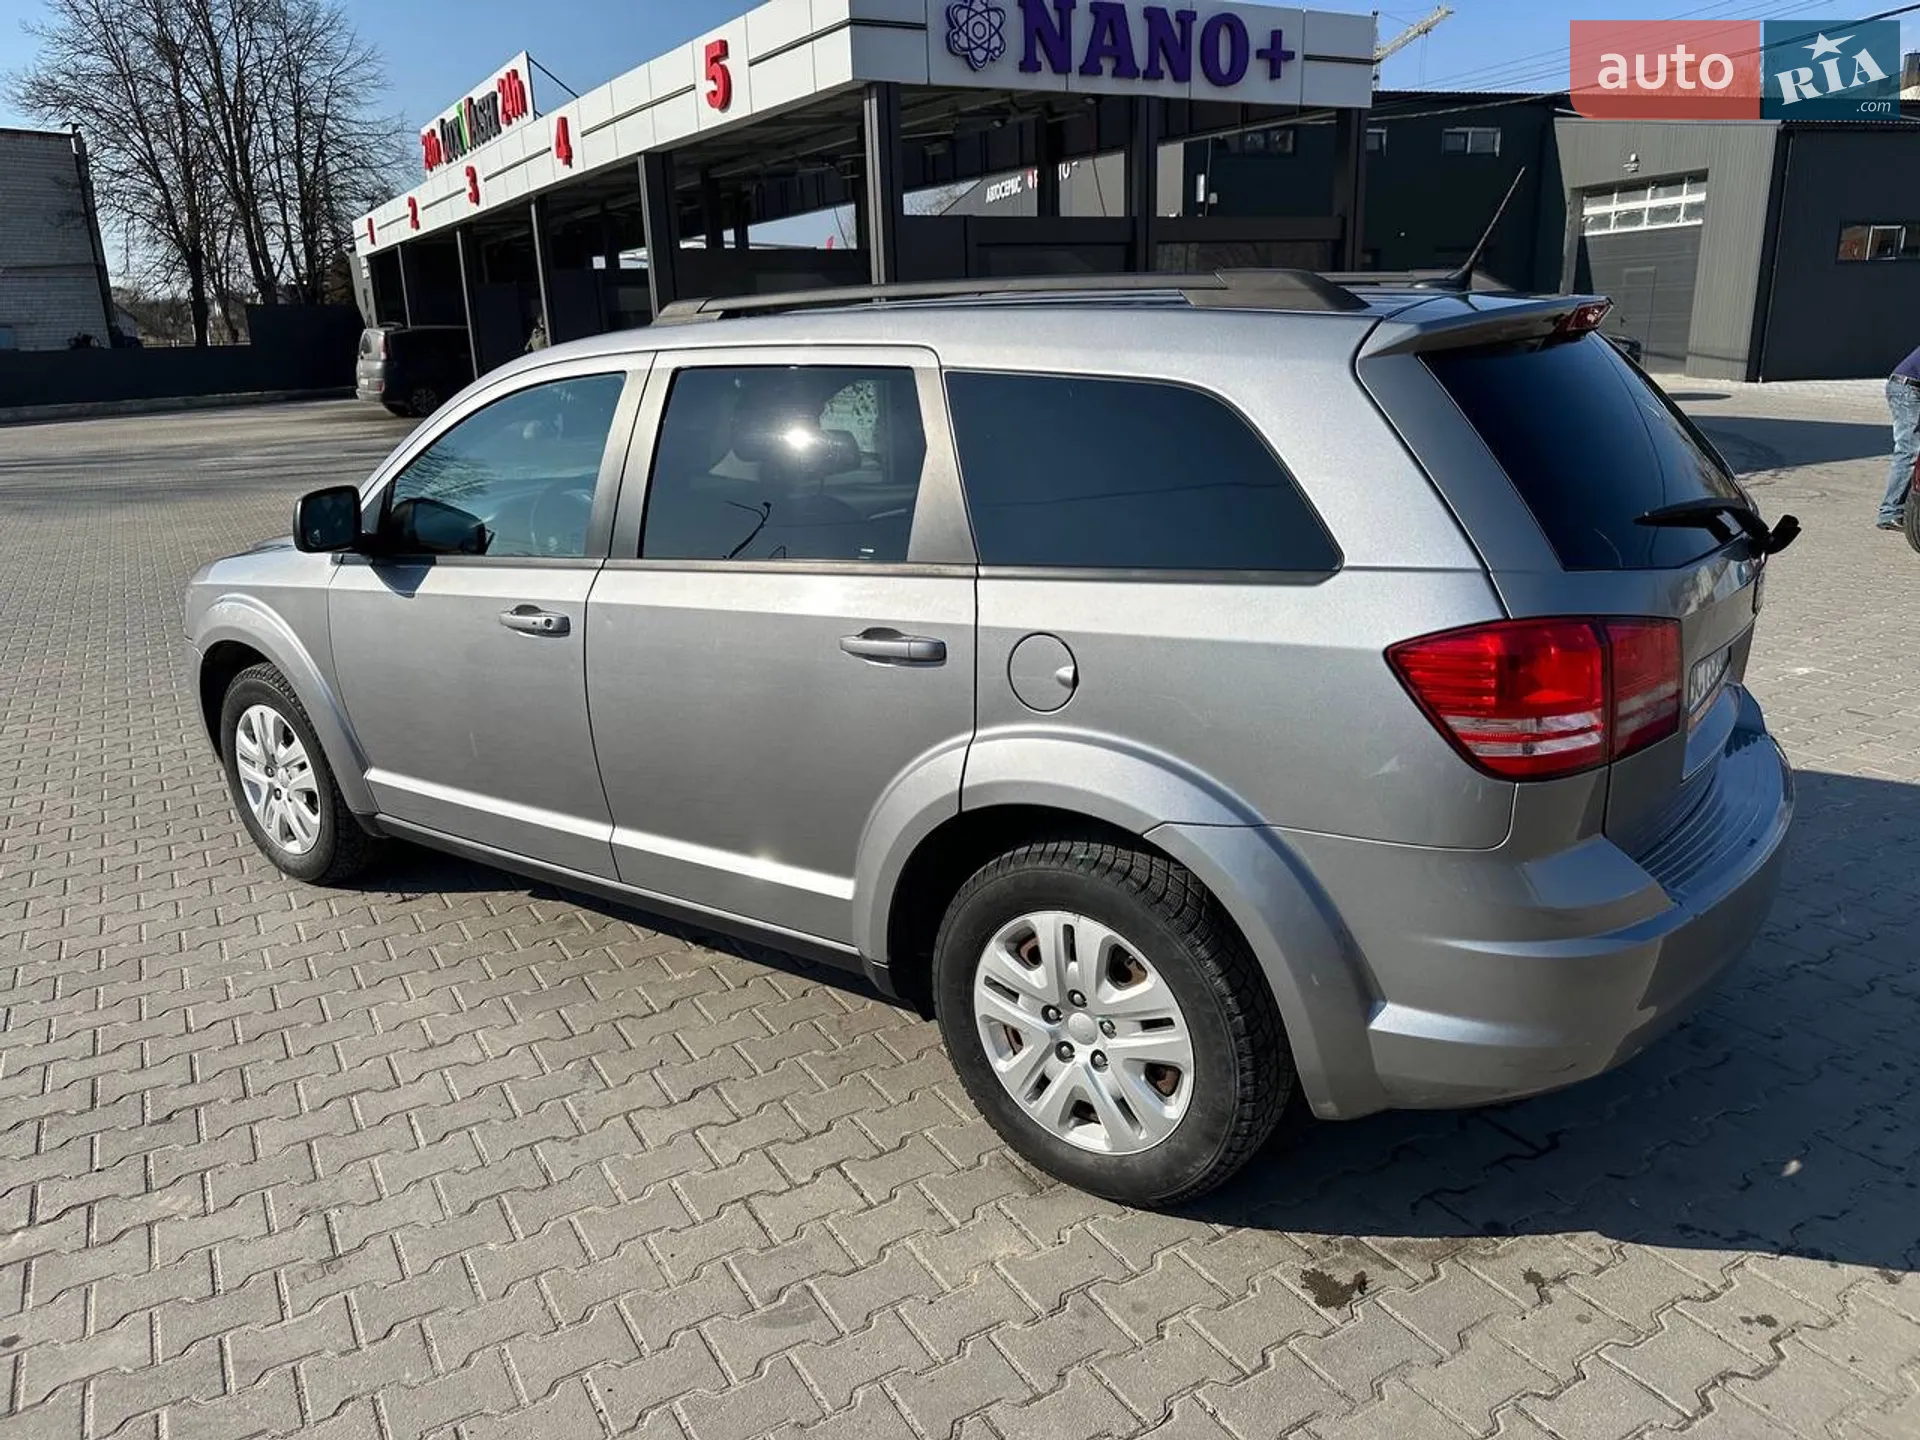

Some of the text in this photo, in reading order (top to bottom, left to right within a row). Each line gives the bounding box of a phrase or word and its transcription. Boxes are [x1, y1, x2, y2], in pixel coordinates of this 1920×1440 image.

[1018, 0, 1296, 87] NANO+
[497, 69, 528, 127] 24h
[705, 39, 732, 112] 5
[555, 116, 573, 168] 4
[465, 166, 480, 206] 3
[367, 217, 376, 246] 1
[408, 196, 420, 231] 2
